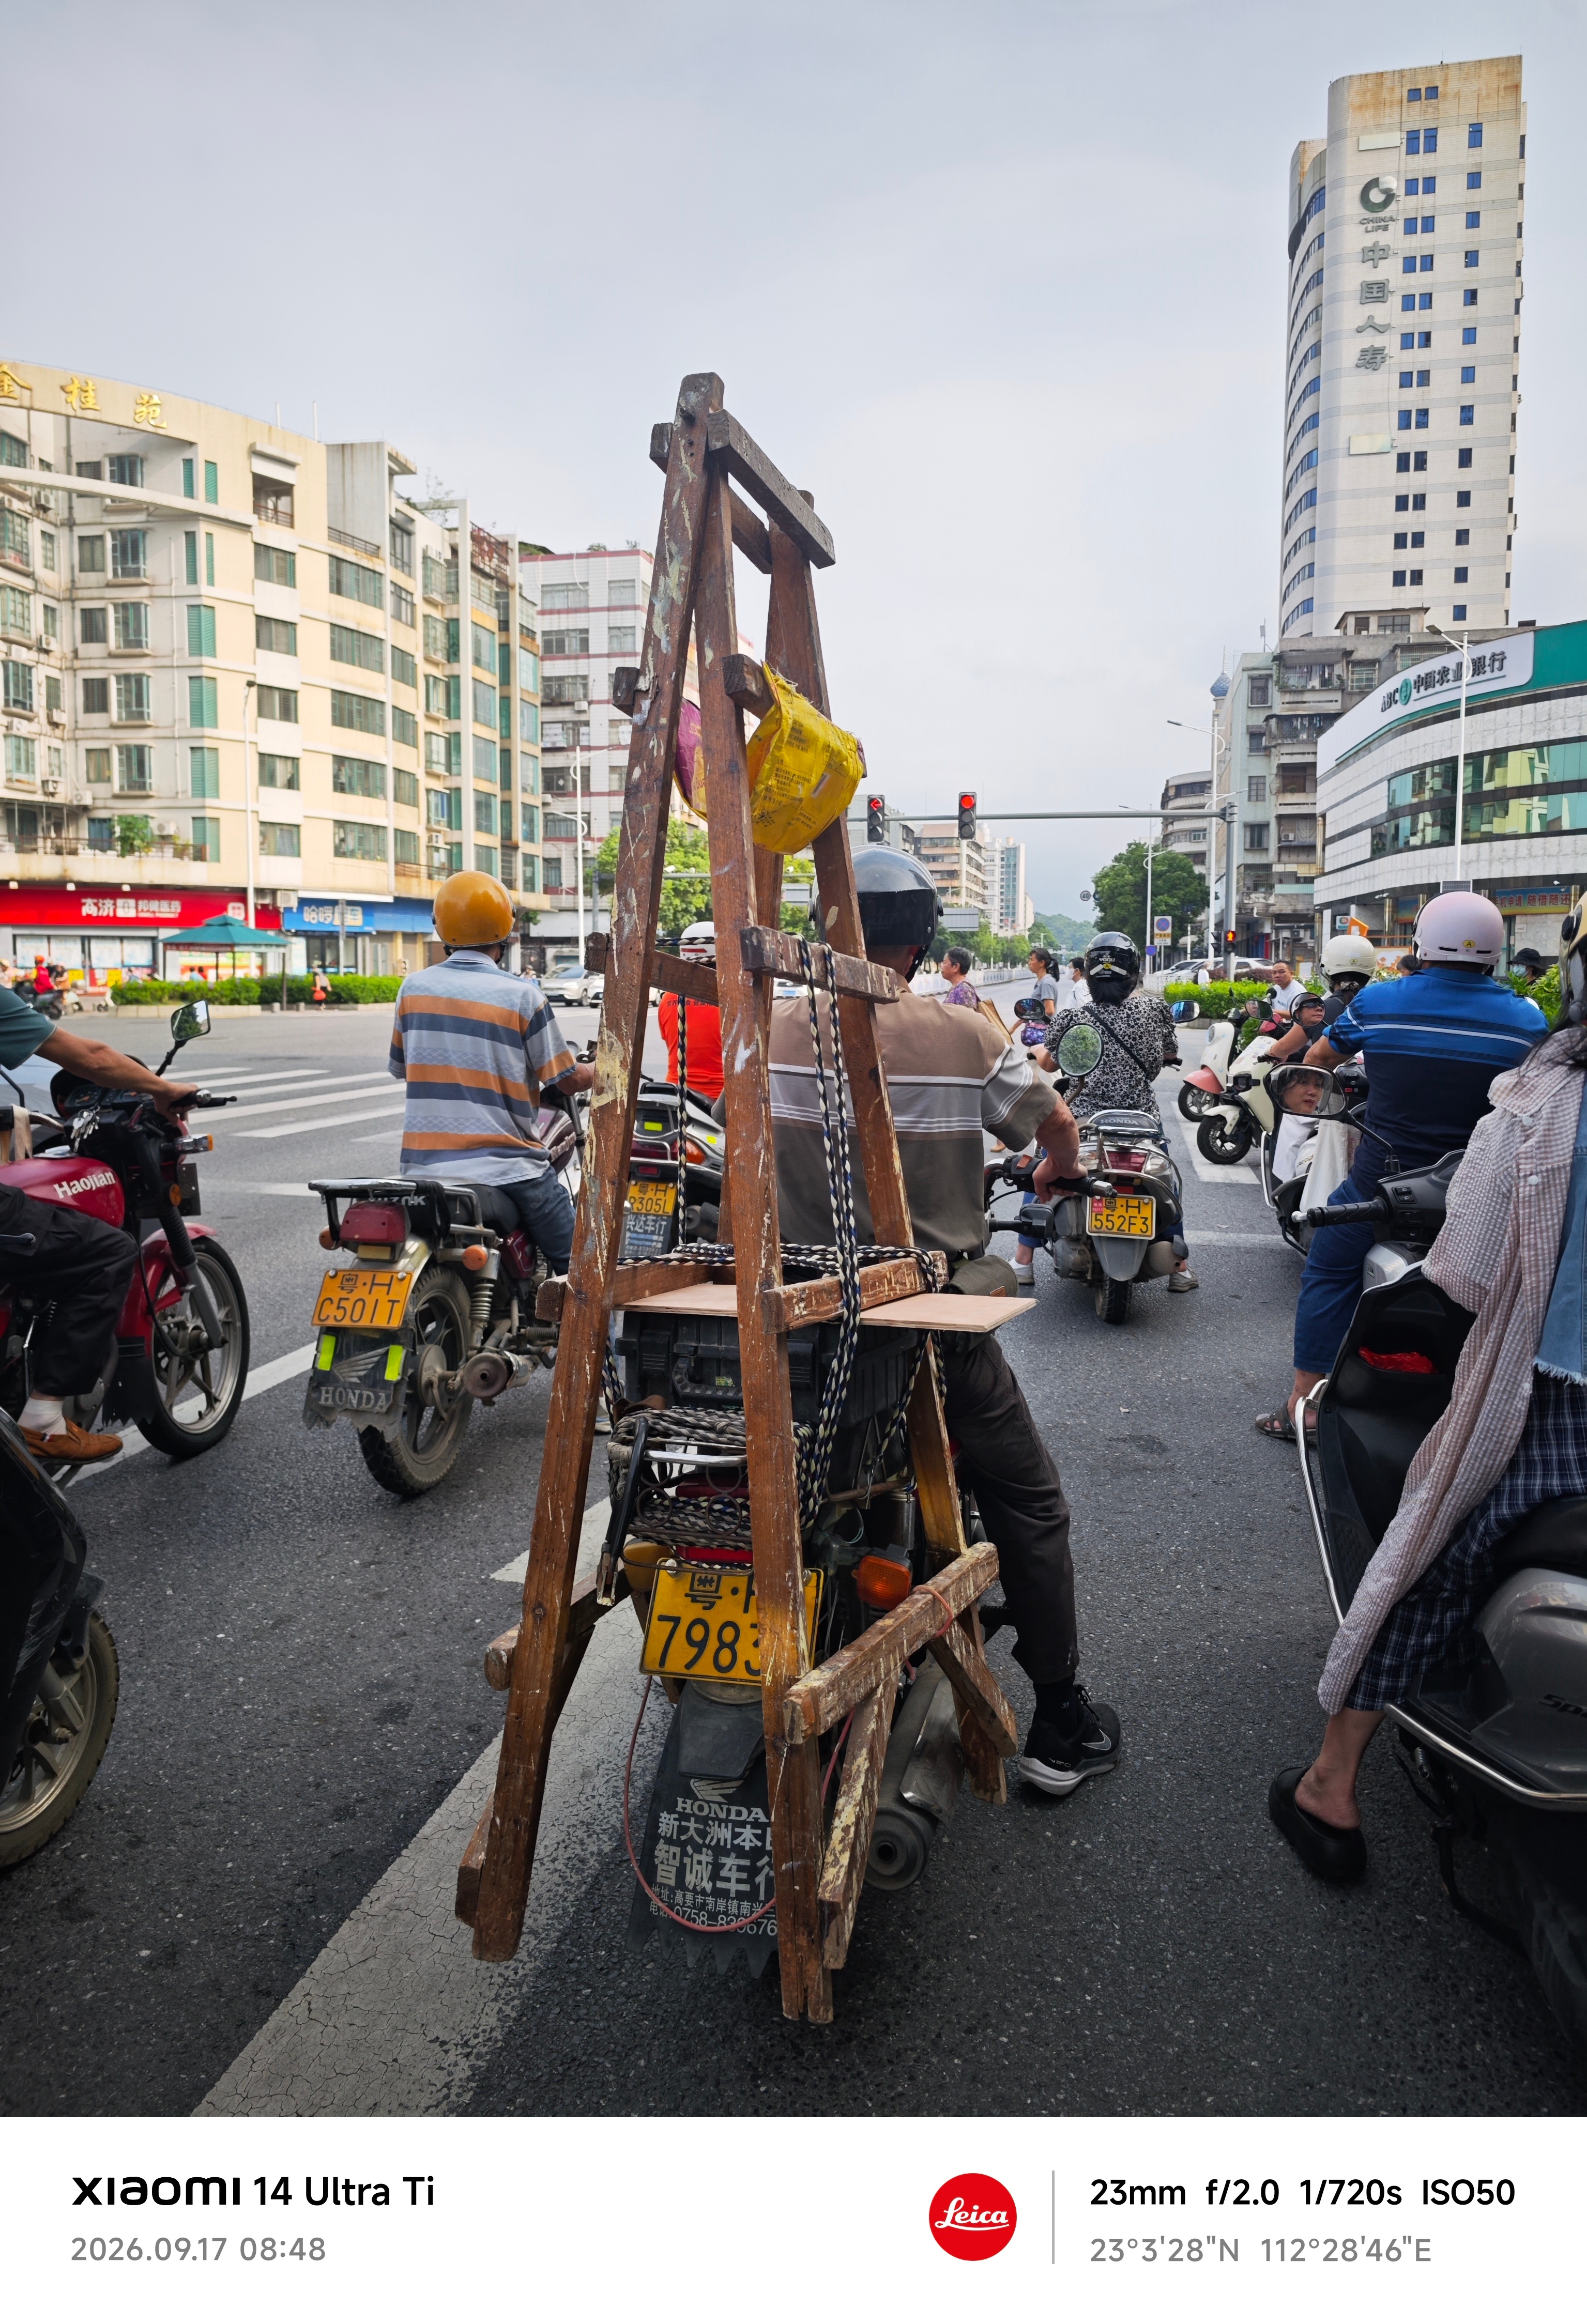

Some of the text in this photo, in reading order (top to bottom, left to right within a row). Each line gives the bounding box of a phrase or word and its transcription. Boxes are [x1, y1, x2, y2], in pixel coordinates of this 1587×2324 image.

[1360, 216, 1396, 225] CHINA
[1365, 224, 1389, 233] LIFE
[1356, 240, 1391, 371] 中国人寿
[1381, 651, 1507, 713] ABC 中国农业银行
[53, 1171, 116, 1199] Haojian
[638, 1183, 668, 1197] 粤·H
[629, 1196, 669, 1214] R305L
[1103, 1199, 1141, 1214] 粤·H
[1094, 1213, 1149, 1234] 552F3
[338, 1273, 394, 1296] 粤·H
[317, 1297, 400, 1325] C501T
[319, 1387, 388, 1412] HONDA
[676, 1797, 769, 1822] HONDA
